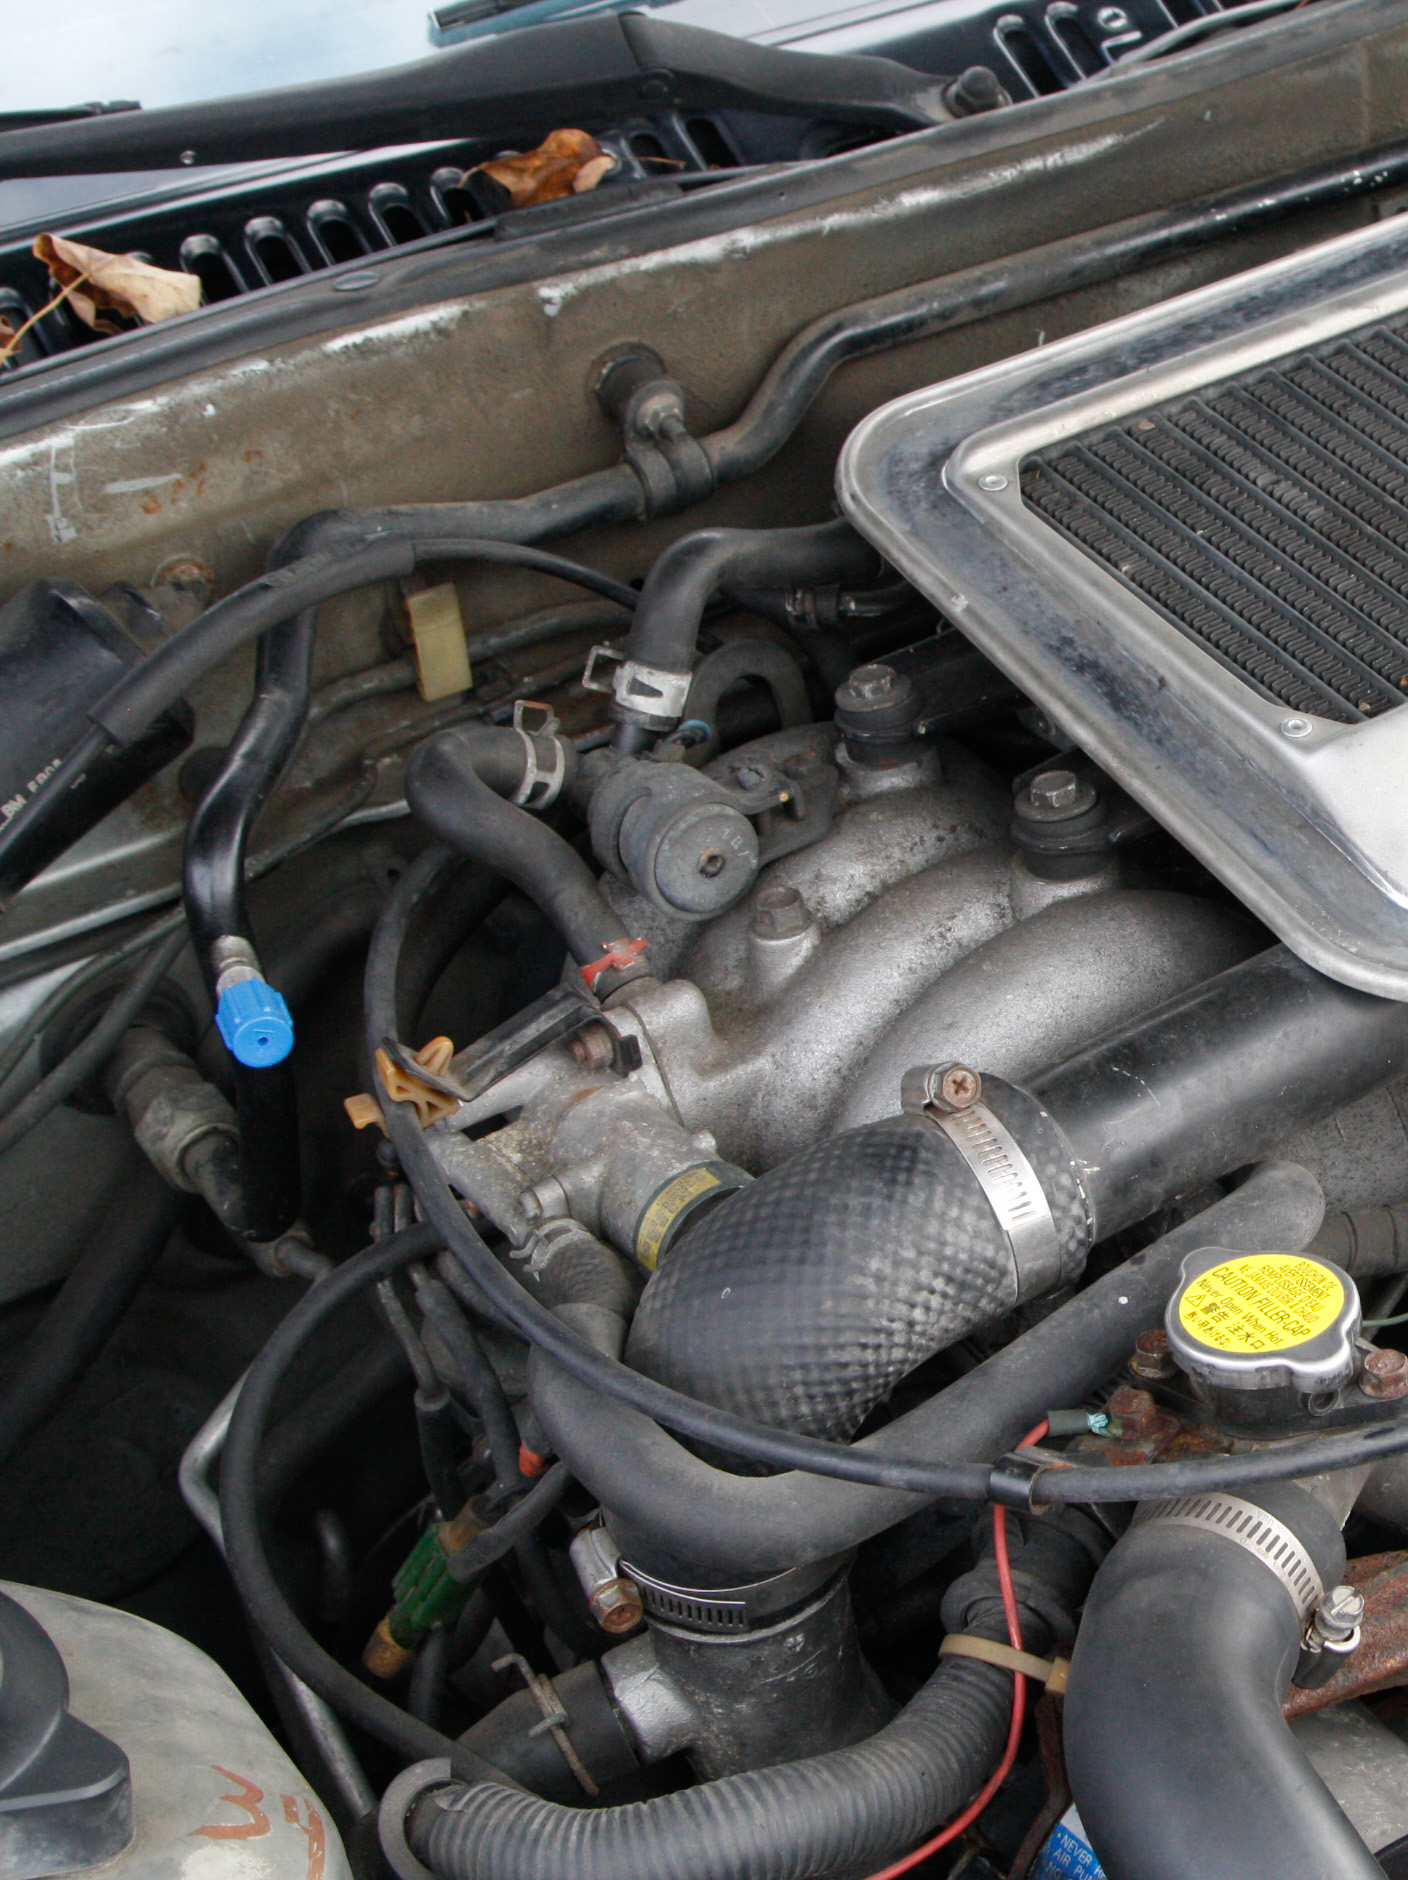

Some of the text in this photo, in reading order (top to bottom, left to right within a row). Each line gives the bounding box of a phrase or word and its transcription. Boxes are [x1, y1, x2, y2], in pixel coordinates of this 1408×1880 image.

[1259, 1265, 1306, 1297] REMPLISSAGE
[1278, 1264, 1331, 1300] AVERTISSEMENT
[1325, 1280, 1338, 1291] DE
[1196, 1279, 1285, 1347] Never Open When Hot.
[1212, 1267, 1311, 1337] CAUTION FILLER-CAP
[1200, 1302, 1265, 1350] 警告 注水口
[1053, 1849, 1071, 1867] AIR
[1061, 1834, 1092, 1867] NEVER
